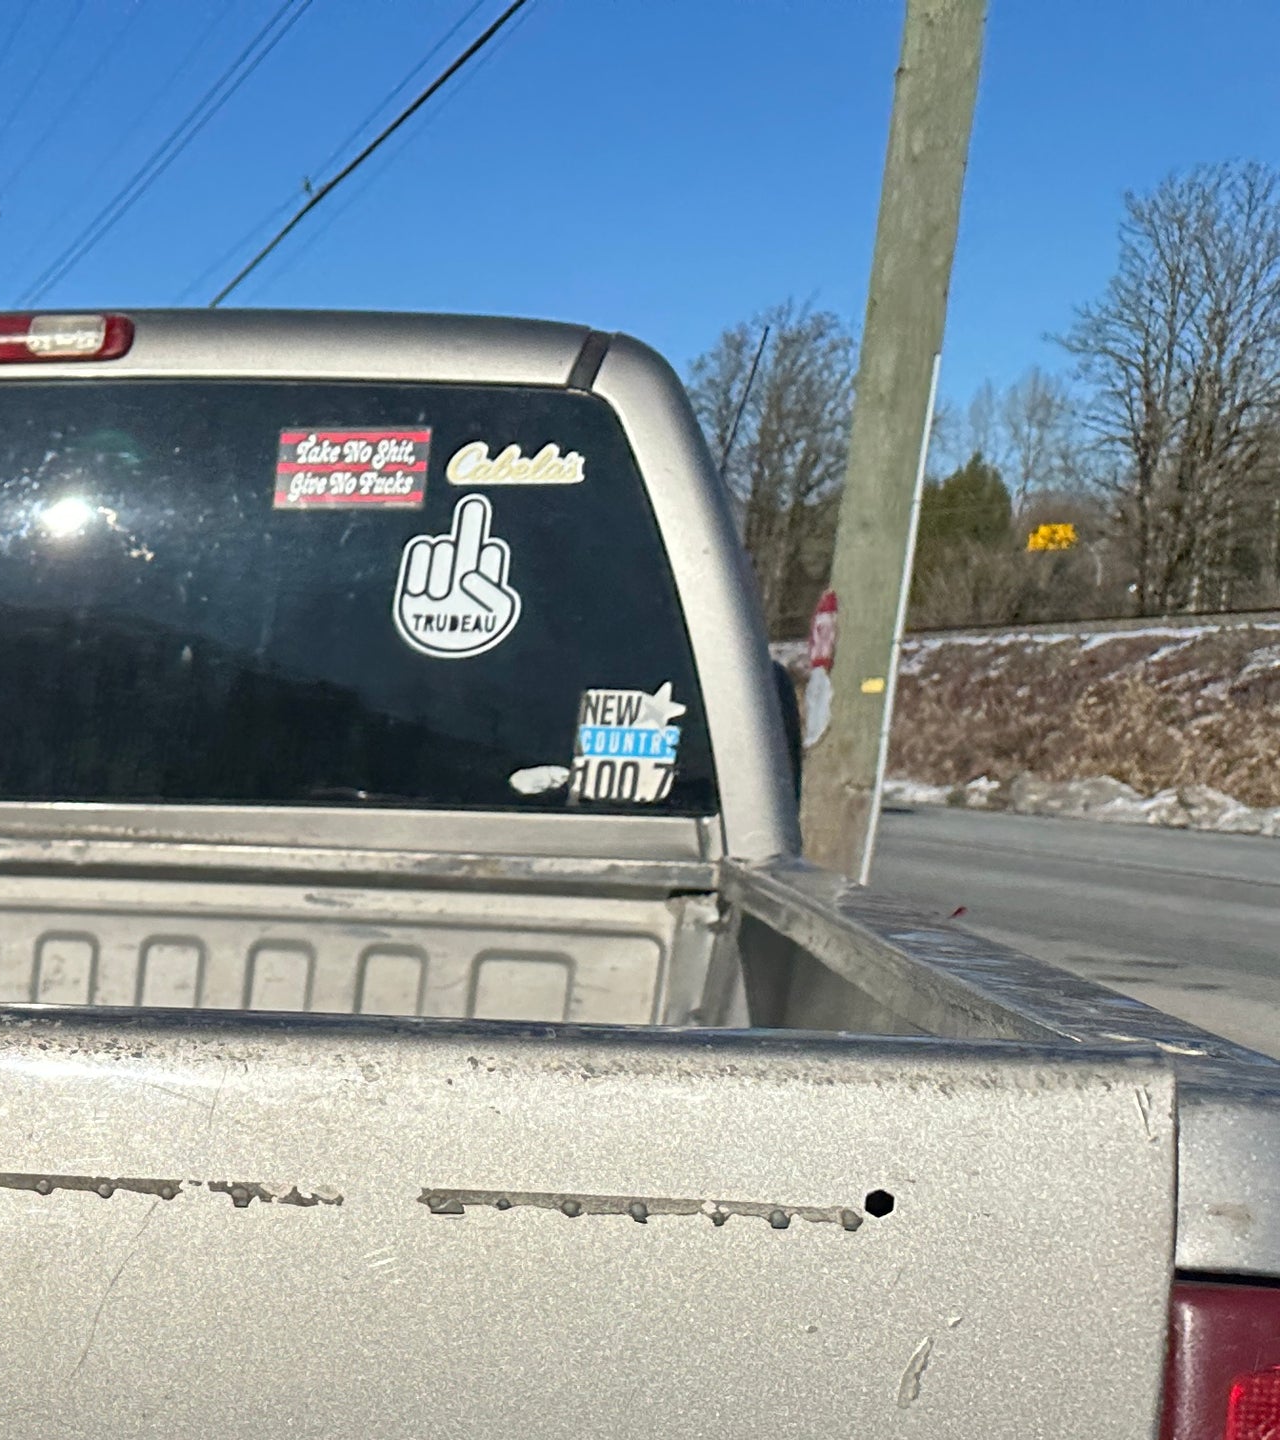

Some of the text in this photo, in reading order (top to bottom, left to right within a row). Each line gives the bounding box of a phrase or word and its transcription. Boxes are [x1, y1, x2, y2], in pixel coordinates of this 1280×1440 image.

[296, 434, 416, 470] Take No Shit,
[287, 471, 414, 502] Give No Fucks
[412, 612, 497, 633] TRUDEAU
[582, 693, 642, 726] NEW
